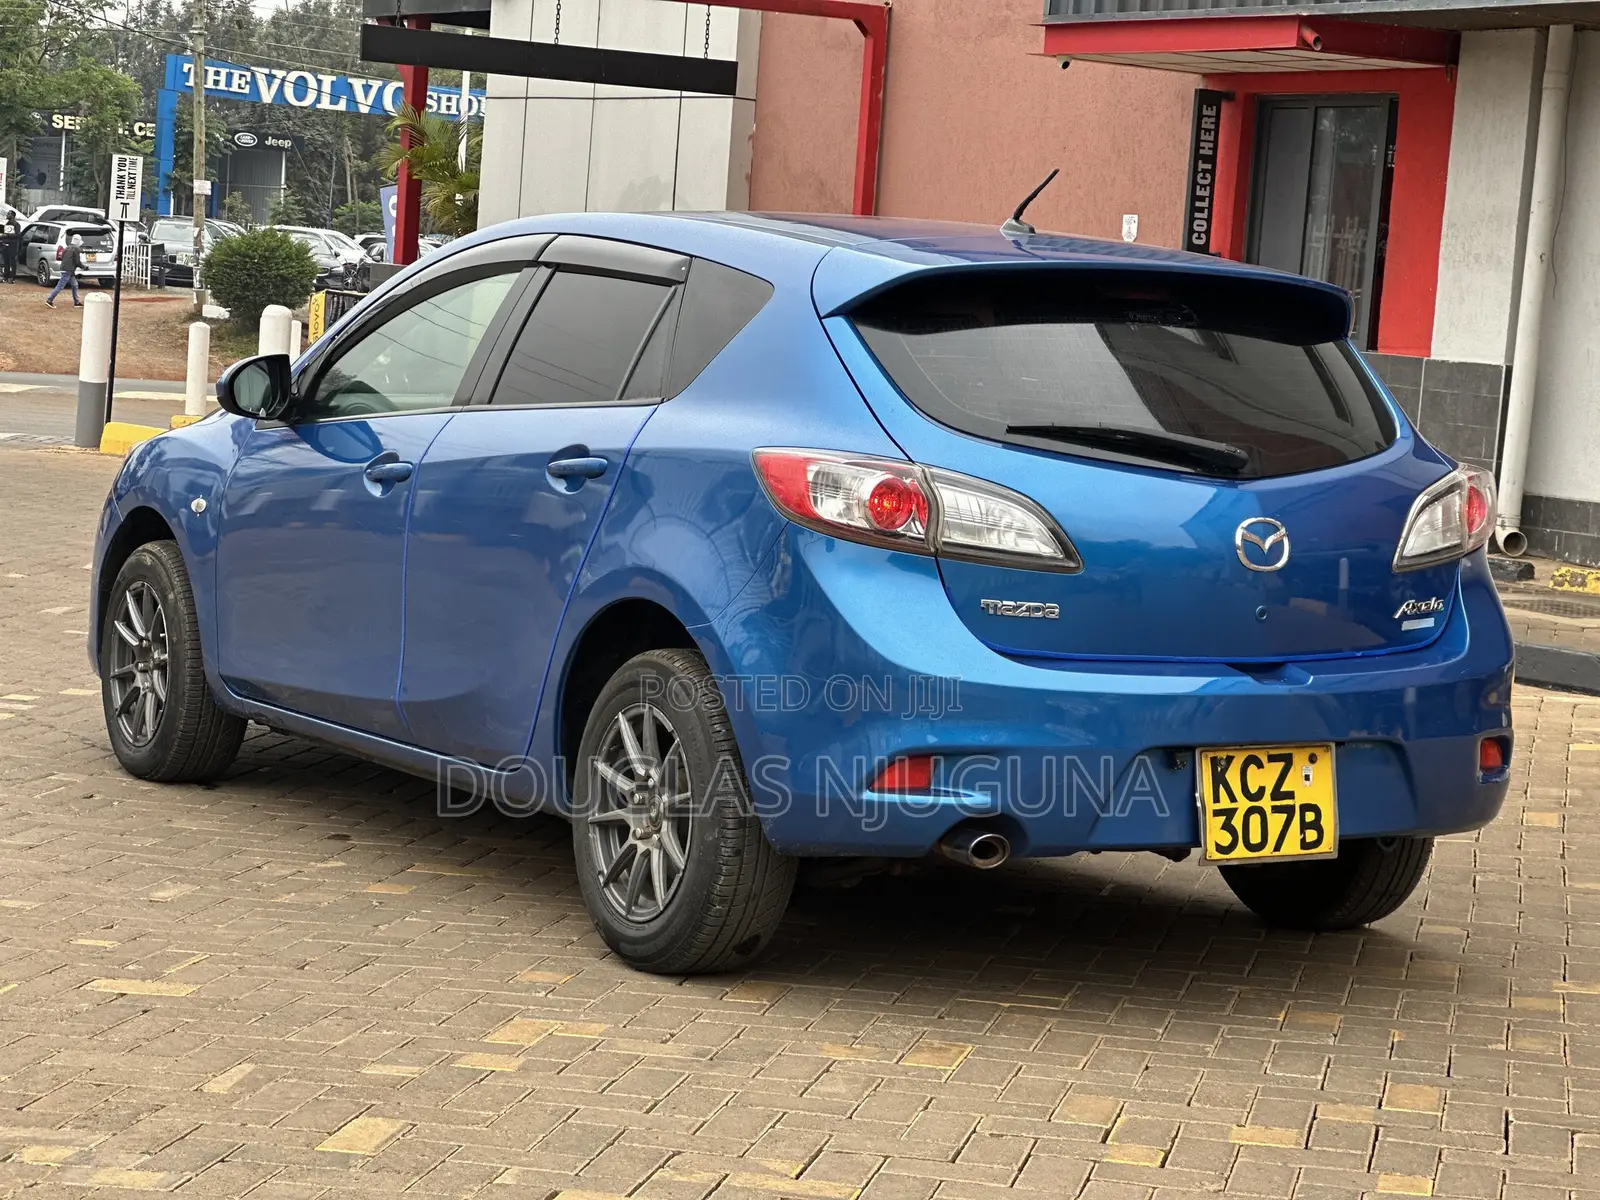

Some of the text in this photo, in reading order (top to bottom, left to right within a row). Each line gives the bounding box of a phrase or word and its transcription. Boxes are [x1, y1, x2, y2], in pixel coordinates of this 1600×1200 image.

[183, 63, 250, 94] THE
[265, 136, 292, 149] Jeep
[116, 157, 127, 200] THANK YOU
[126, 157, 138, 200] TILL NEXT TIME
[1192, 104, 1217, 245] COLLECT HERE
[1209, 752, 1296, 805] KCZ
[1212, 803, 1325, 856] 307B
